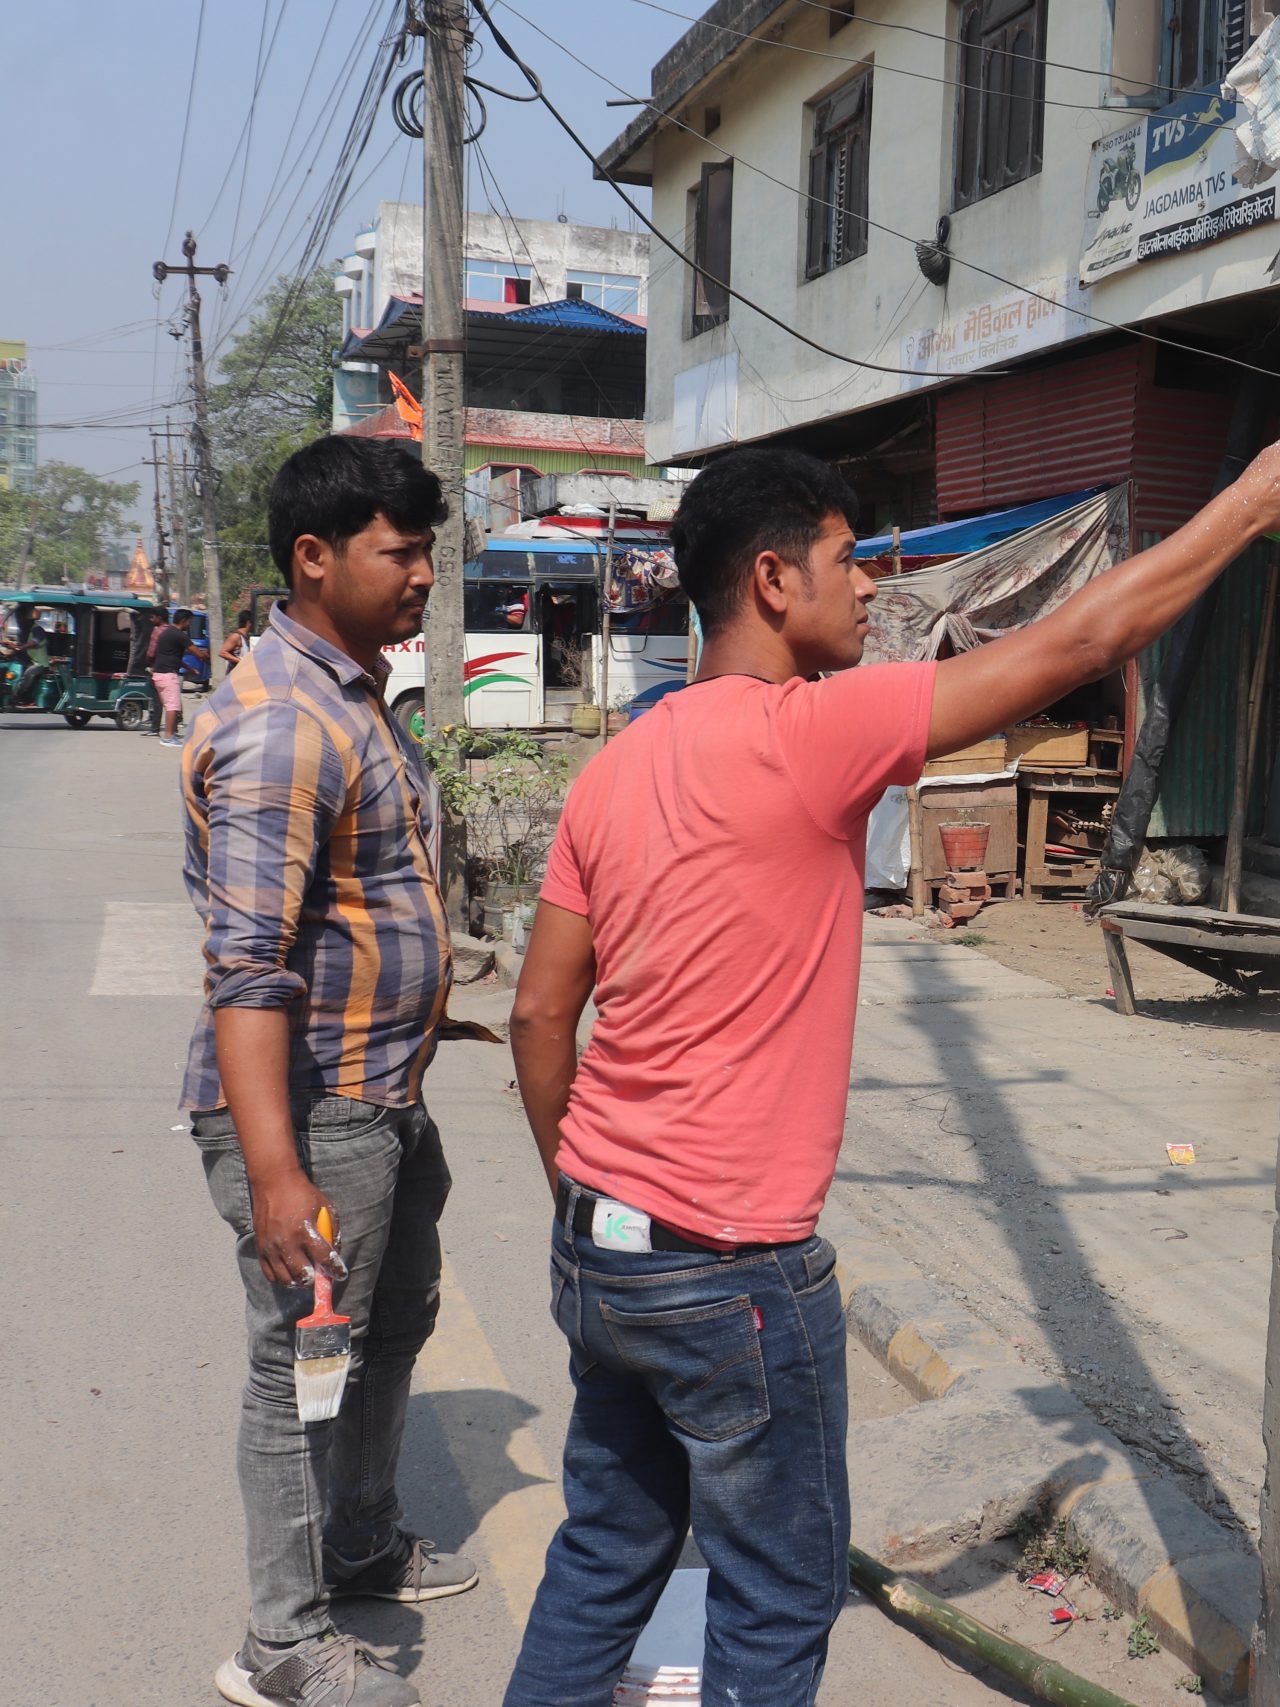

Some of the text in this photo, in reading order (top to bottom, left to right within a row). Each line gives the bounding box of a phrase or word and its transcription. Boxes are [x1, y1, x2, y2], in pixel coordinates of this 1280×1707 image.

[1152, 113, 1187, 153] TVS
[1143, 171, 1226, 219] JAGDAMBA TVS
